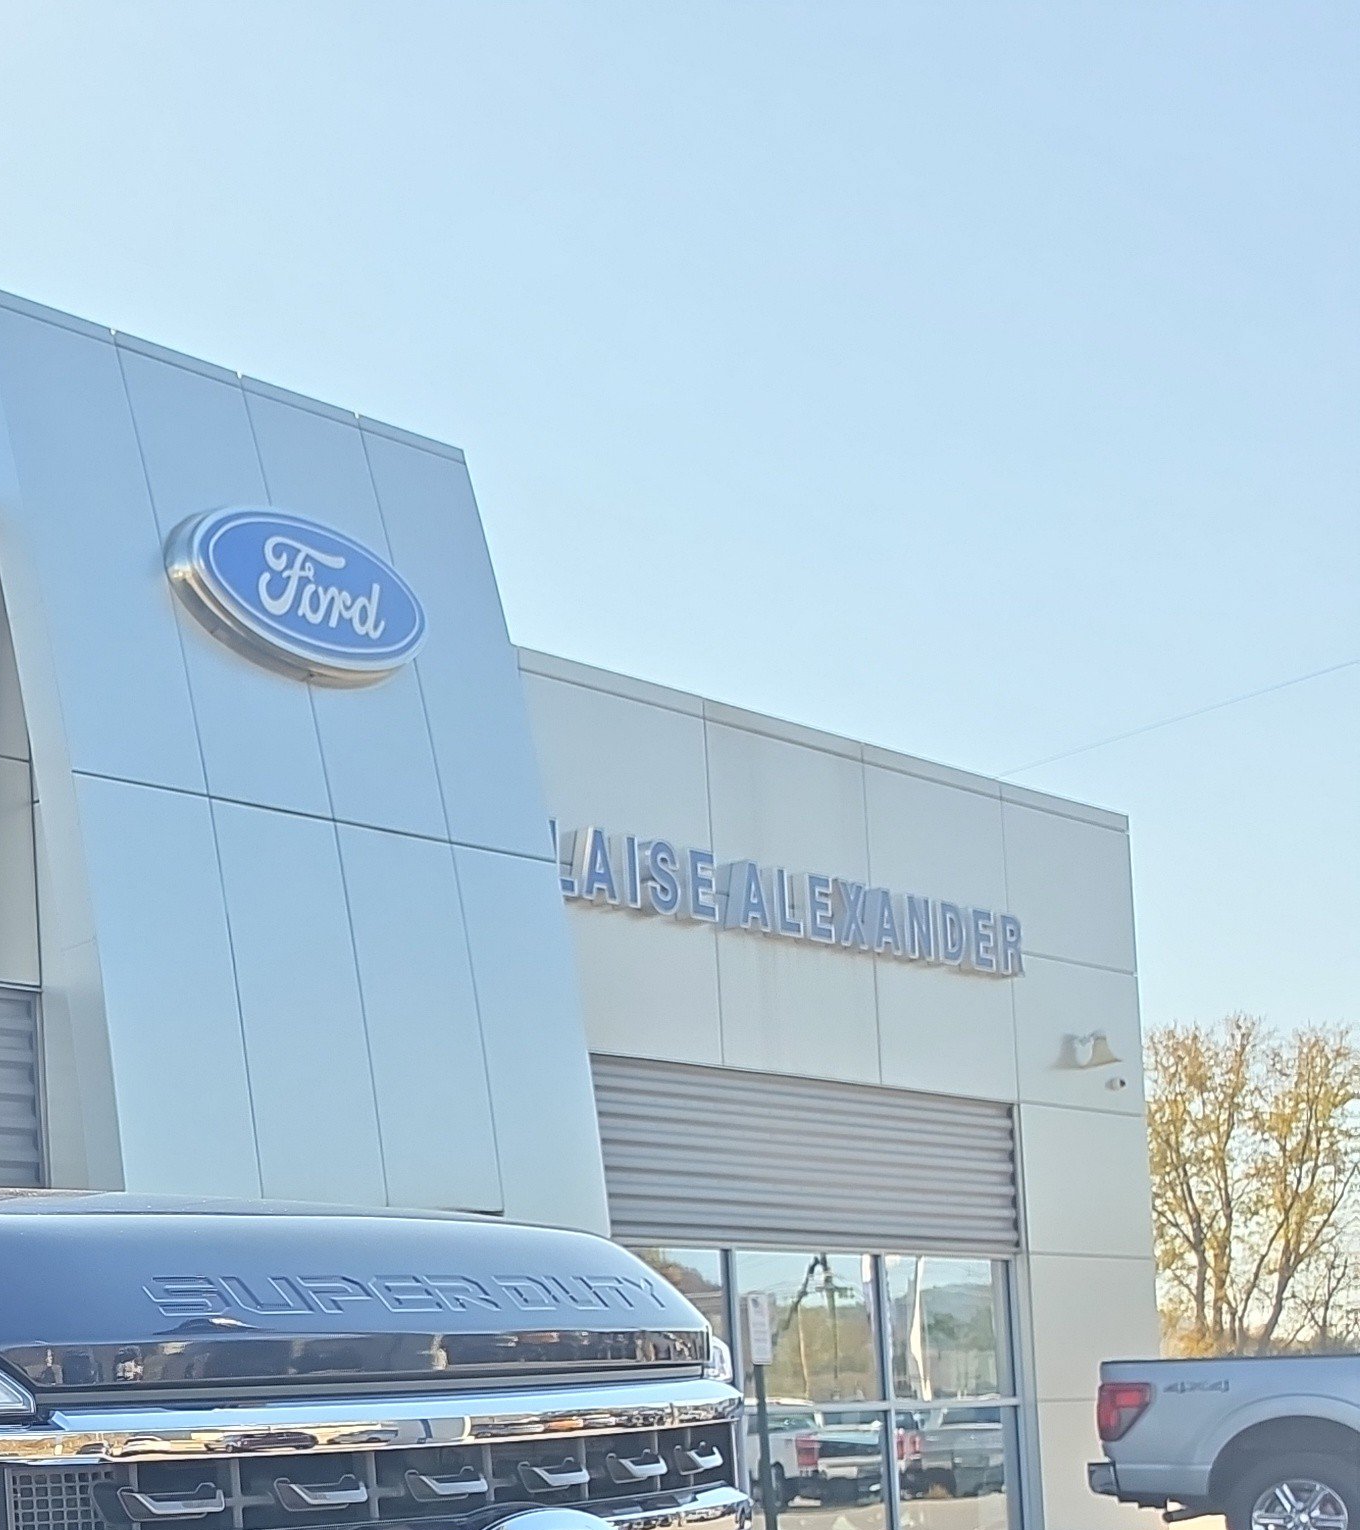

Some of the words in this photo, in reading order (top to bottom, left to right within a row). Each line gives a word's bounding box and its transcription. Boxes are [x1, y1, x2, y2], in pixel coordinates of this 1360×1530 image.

[258, 536, 386, 640] Ford
[739, 858, 1024, 977] ALEXANDER
[142, 1275, 502, 1317] SUPER
[491, 1275, 666, 1312] DUTY
